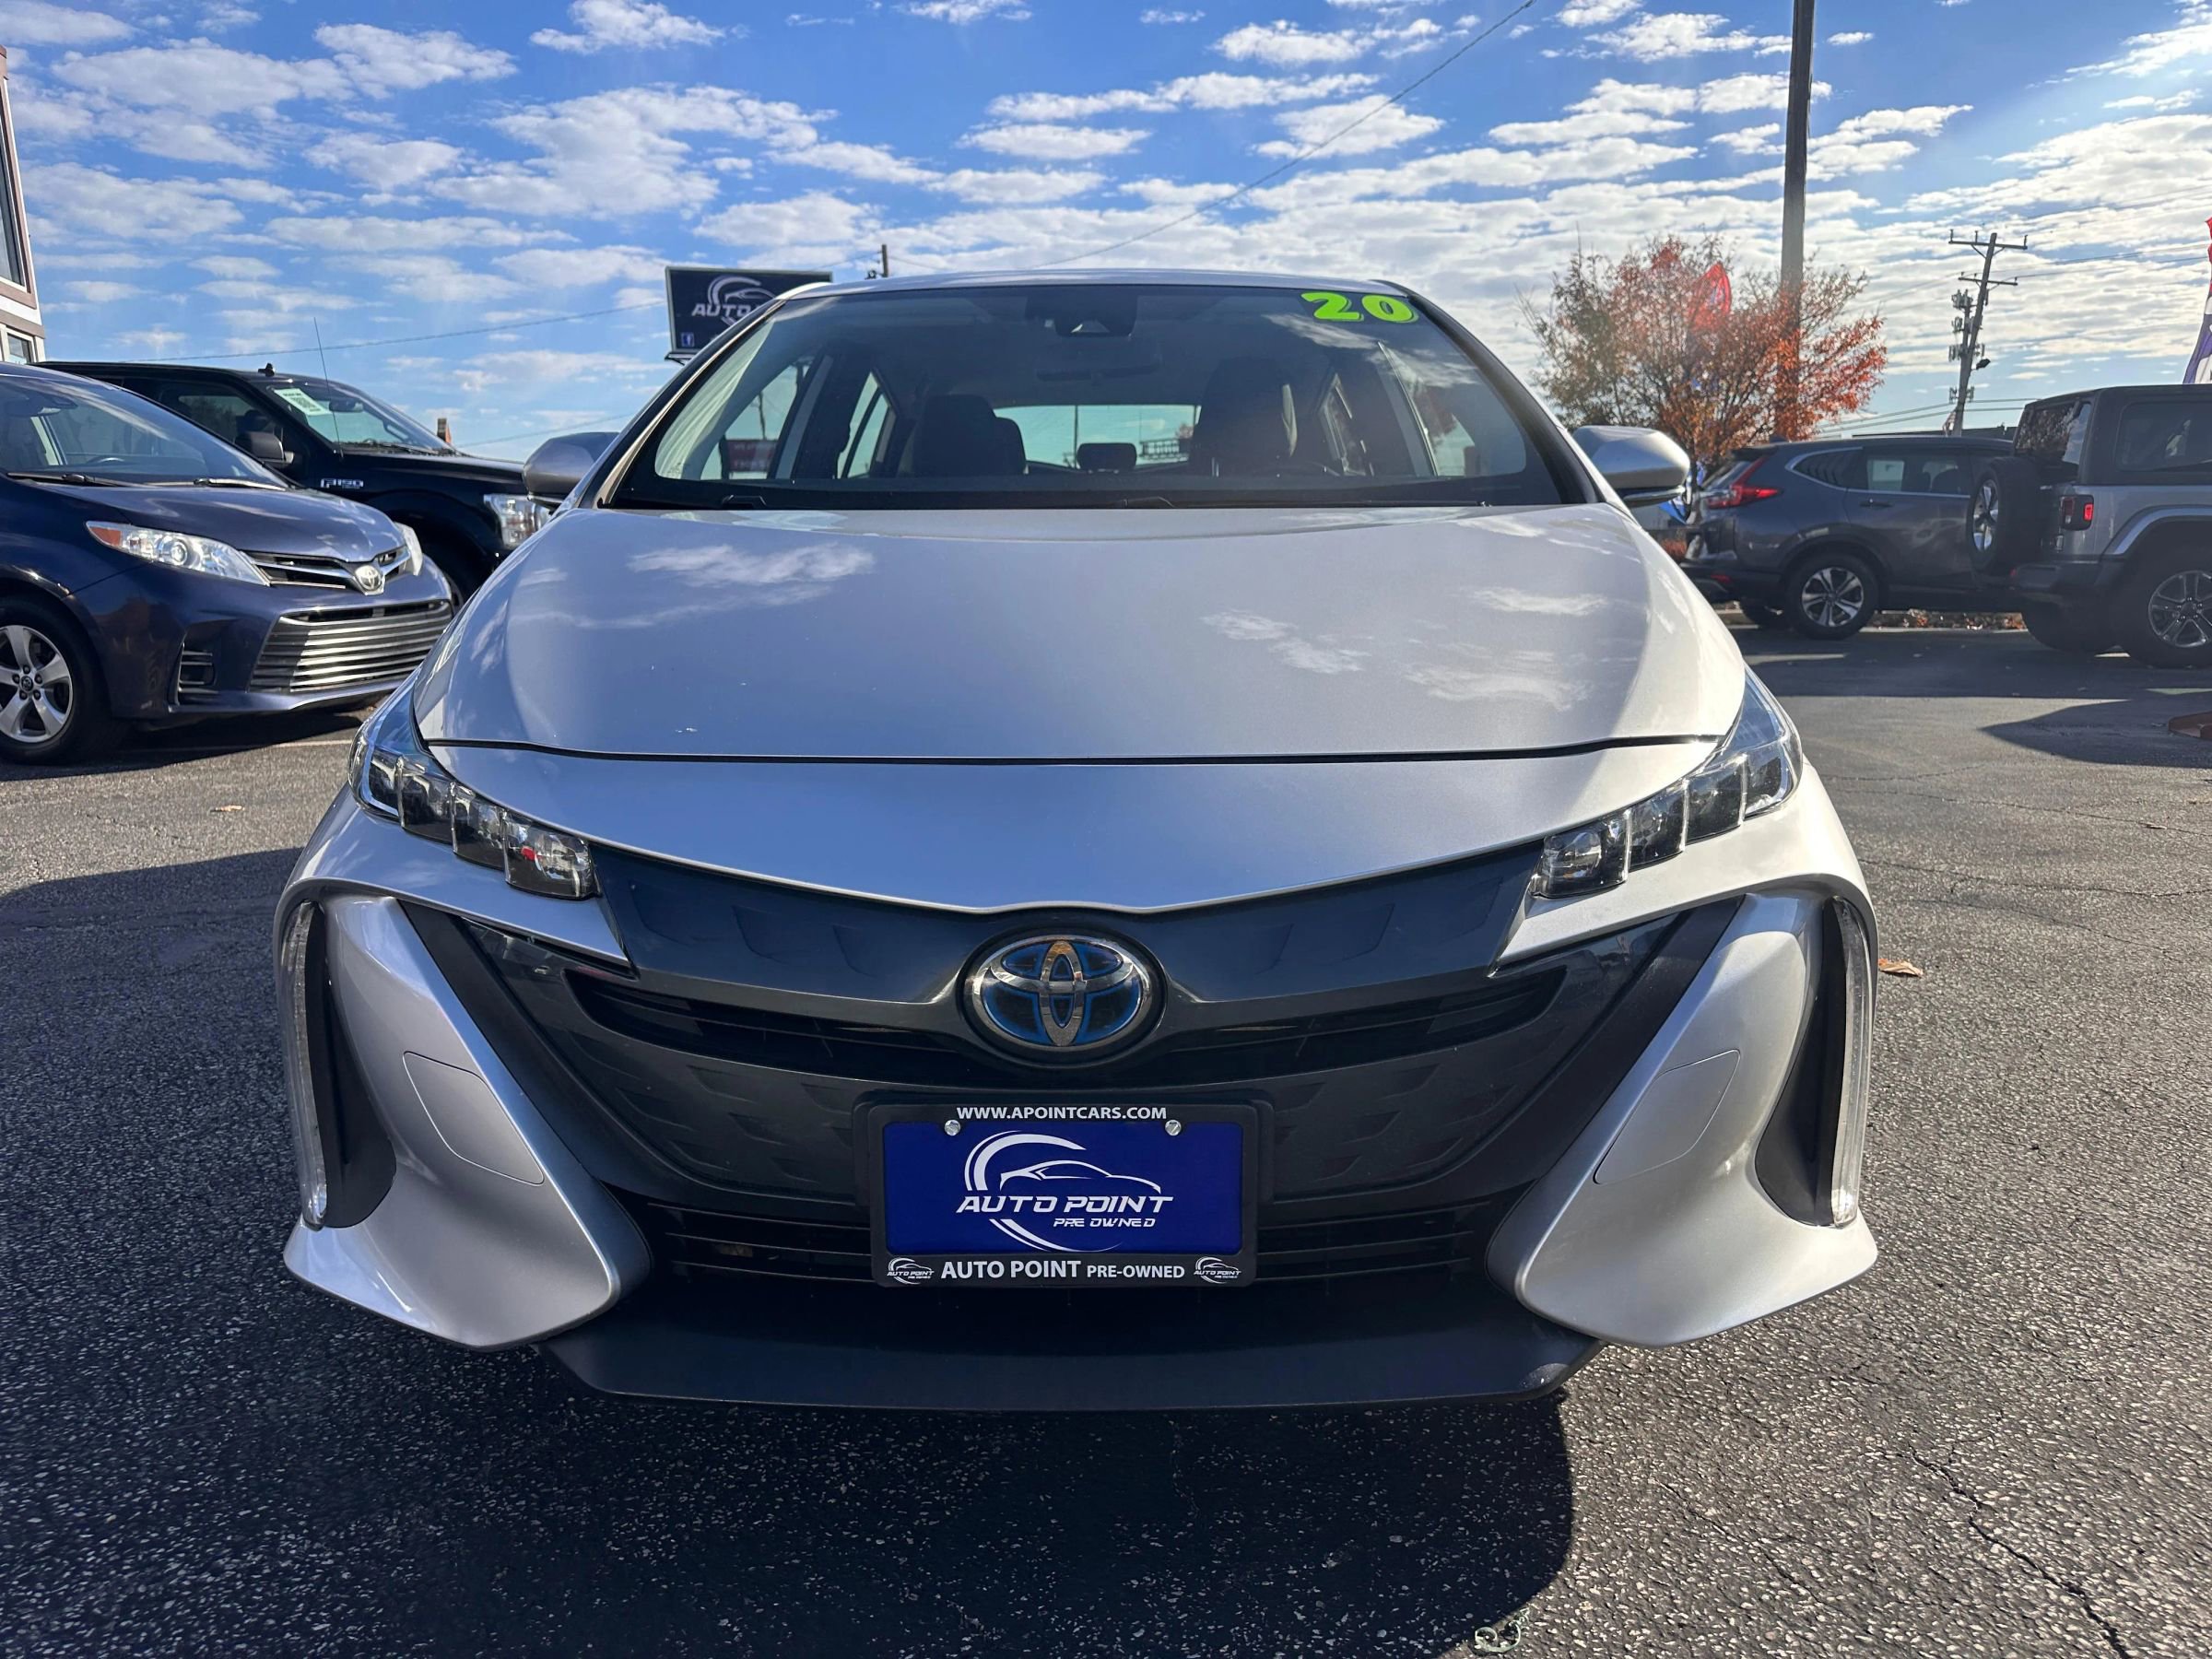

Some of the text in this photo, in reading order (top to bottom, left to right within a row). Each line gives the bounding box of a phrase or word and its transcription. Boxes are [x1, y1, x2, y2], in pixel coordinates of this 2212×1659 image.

[1300, 291, 1419, 323] 20
[956, 1107, 1167, 1120] WWW.APOINTCARS.COM
[956, 1195, 1173, 1213] AUTO POINT
[1053, 1218, 1156, 1228] PRE OWNED
[941, 1260, 1185, 1279] AUTO POINT PRE-OWNED
